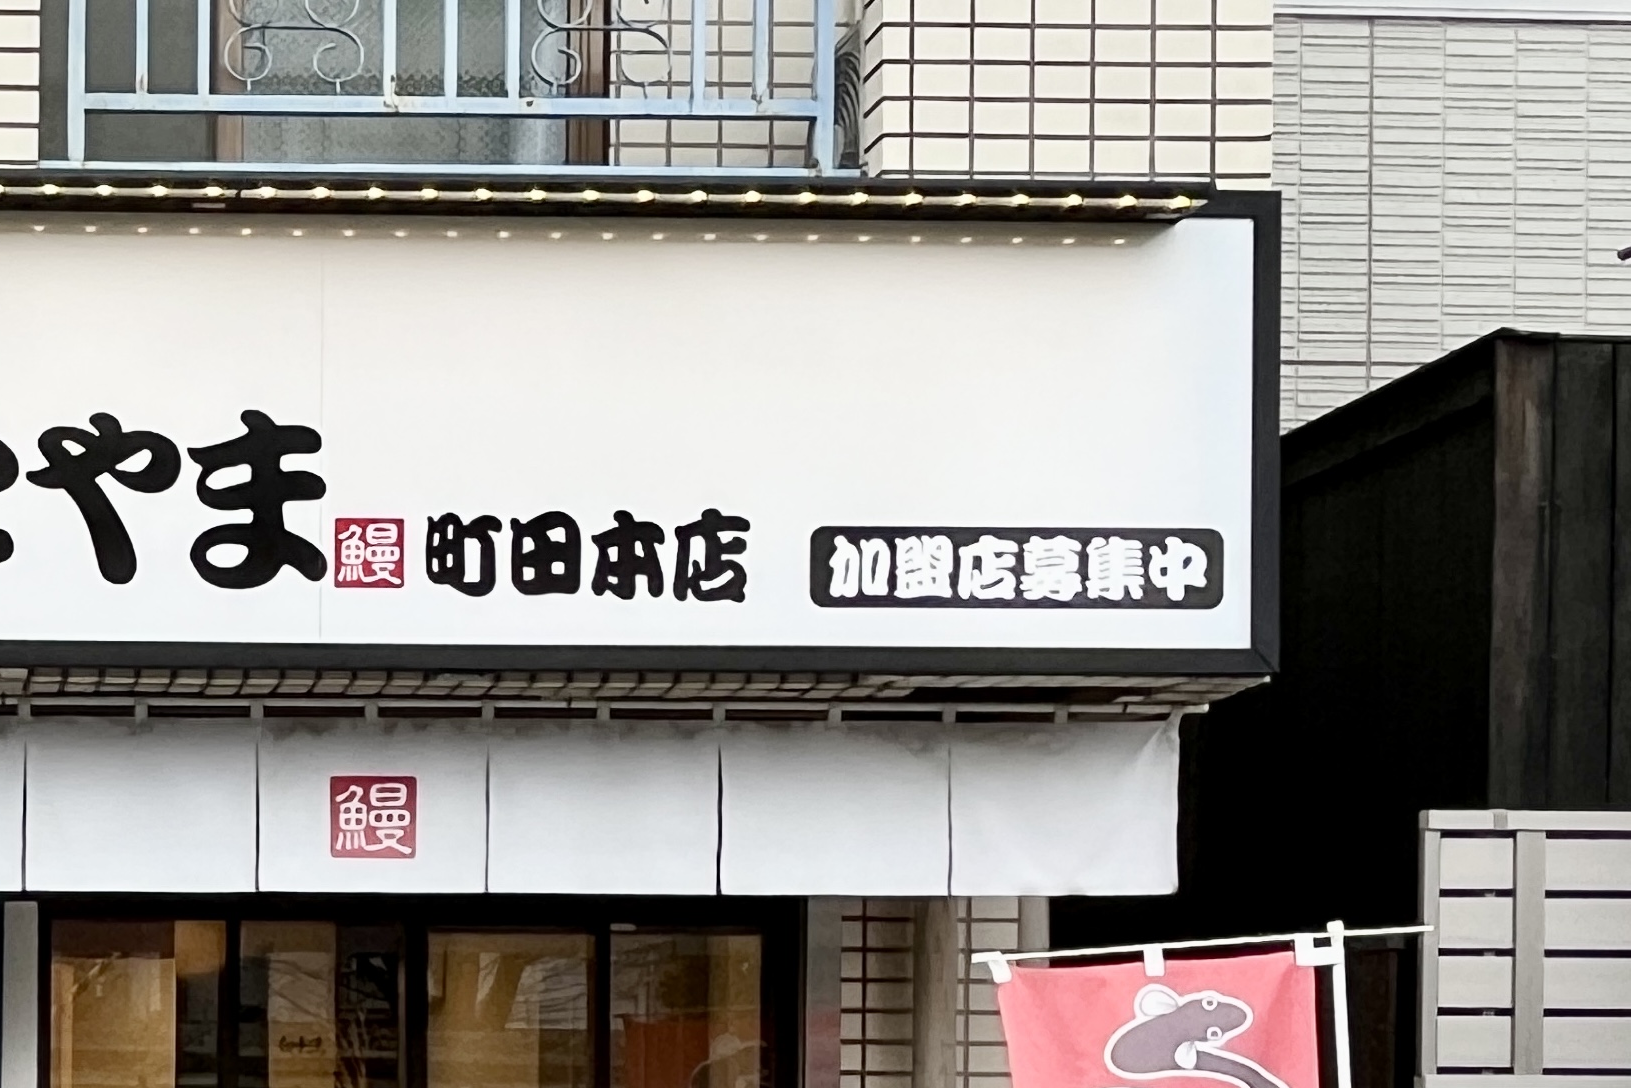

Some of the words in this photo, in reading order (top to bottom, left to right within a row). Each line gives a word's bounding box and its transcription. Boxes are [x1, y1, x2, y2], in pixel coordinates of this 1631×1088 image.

[336, 520, 404, 588] 鰻
[425, 508, 751, 603] 町田本店
[828, 534, 1209, 602] 加盟店募集中
[333, 780, 413, 855] 鰻
